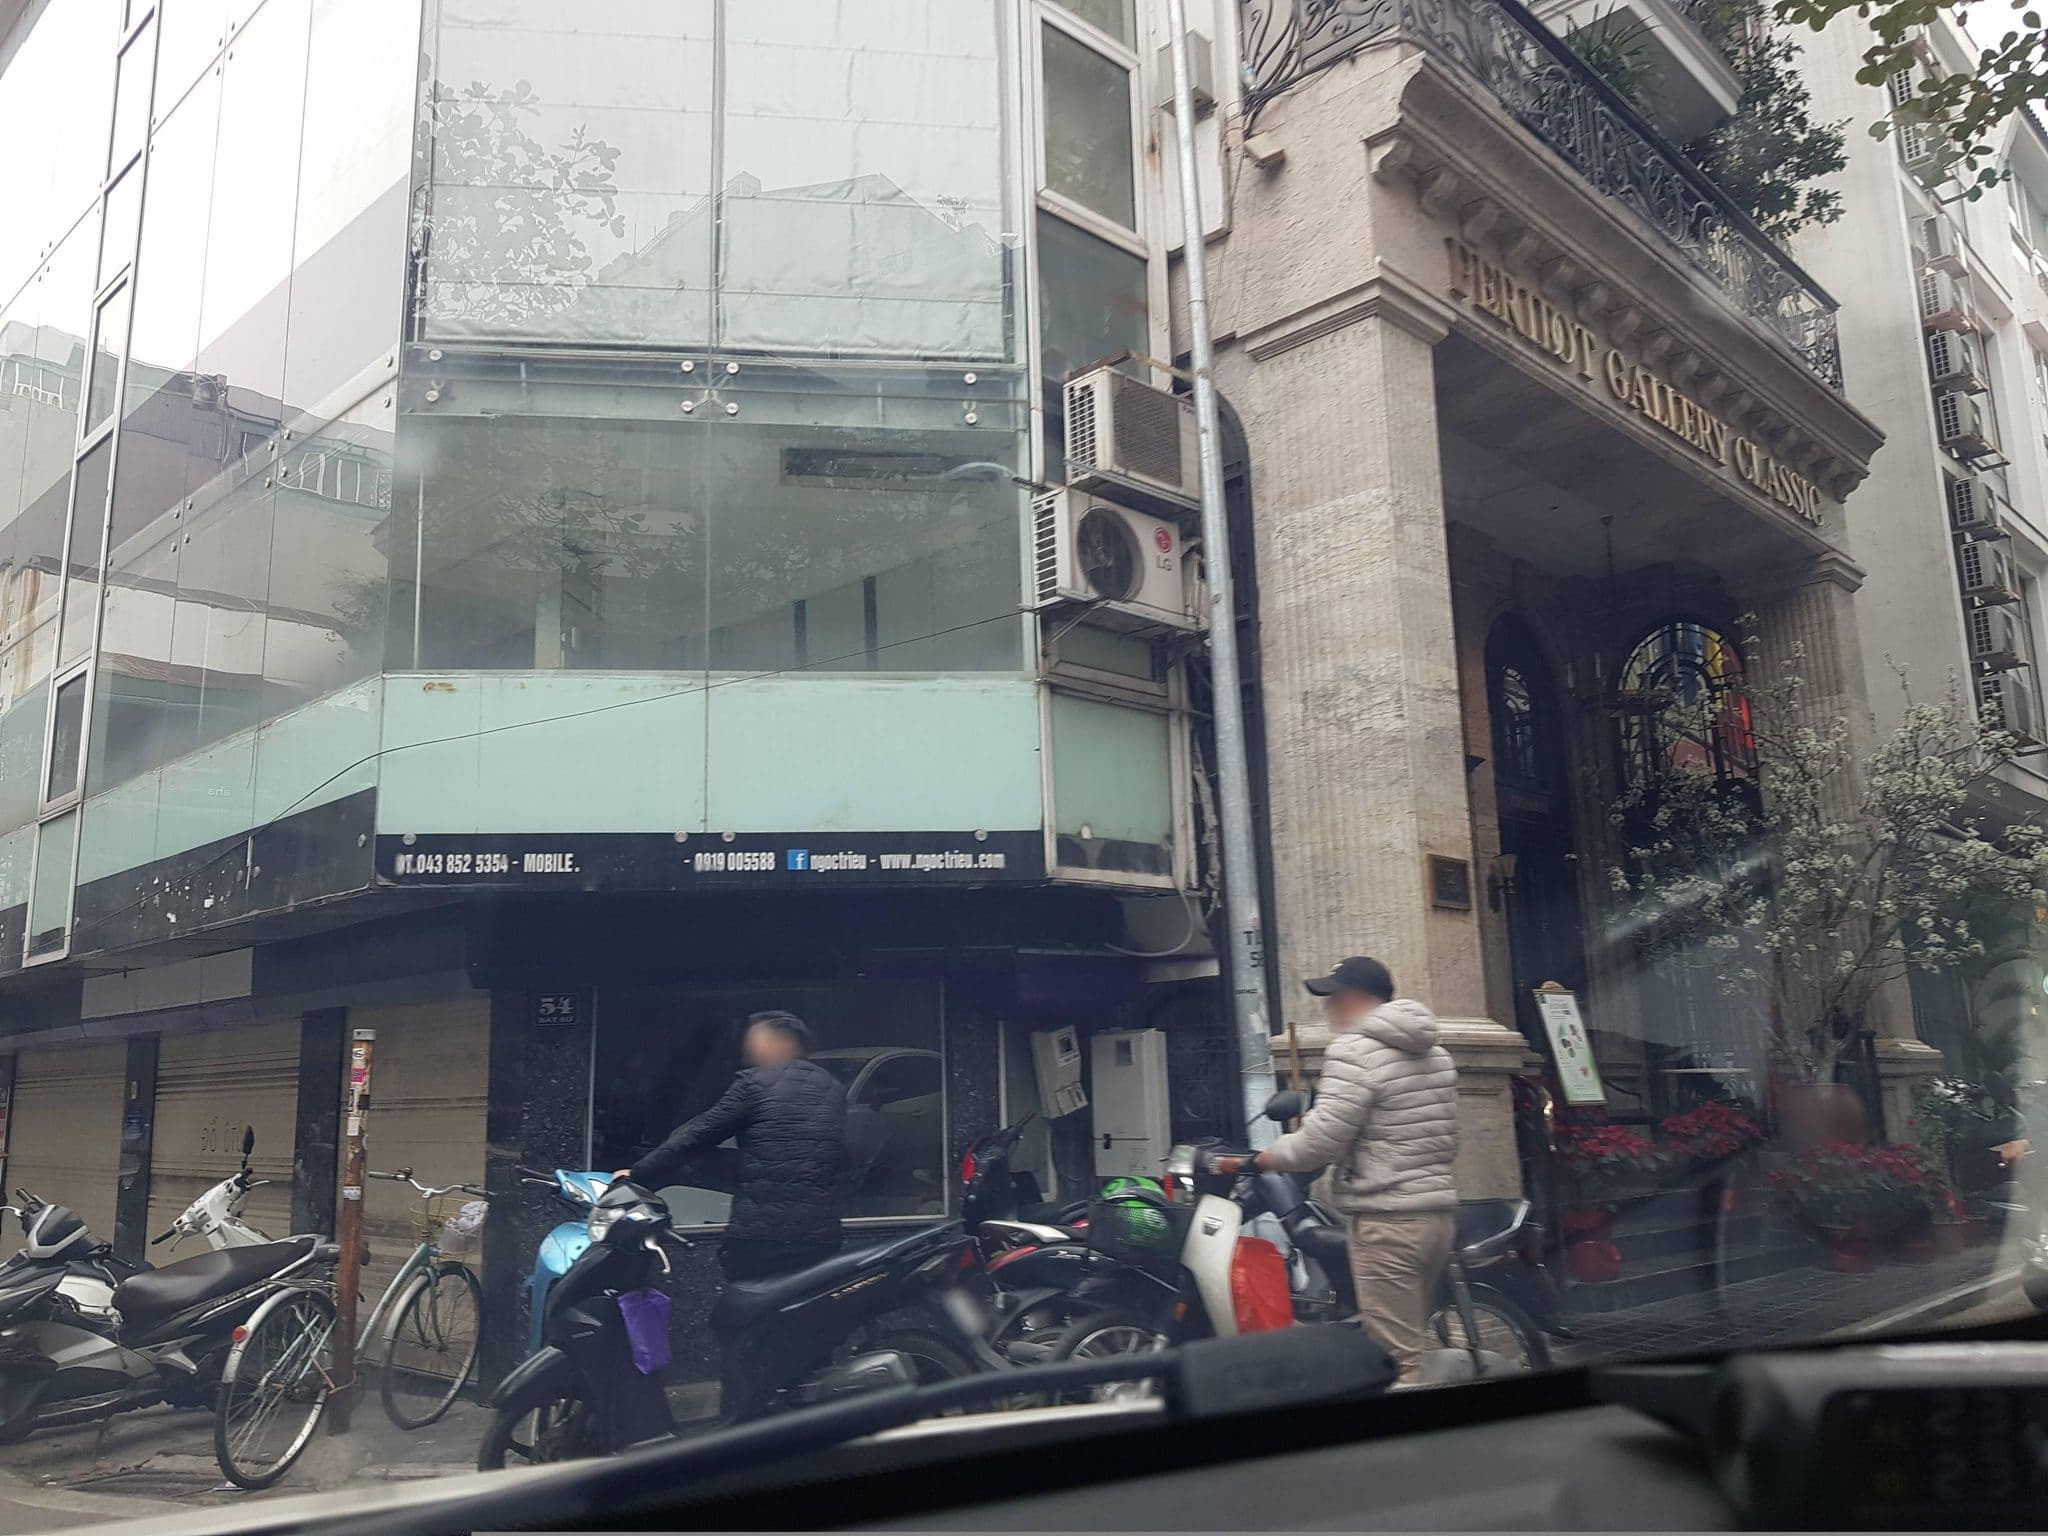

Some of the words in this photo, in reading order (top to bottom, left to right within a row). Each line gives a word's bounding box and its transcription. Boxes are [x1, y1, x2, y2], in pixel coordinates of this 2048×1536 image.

[1446, 236, 1598, 383] PERIDOT
[1605, 346, 1730, 468] GALLERY
[1734, 435, 1825, 528] CLASSIC
[1156, 554, 1172, 571] LG
[446, 853, 472, 874] 852
[475, 853, 508, 874] 5354
[727, 852, 776, 872] 005588
